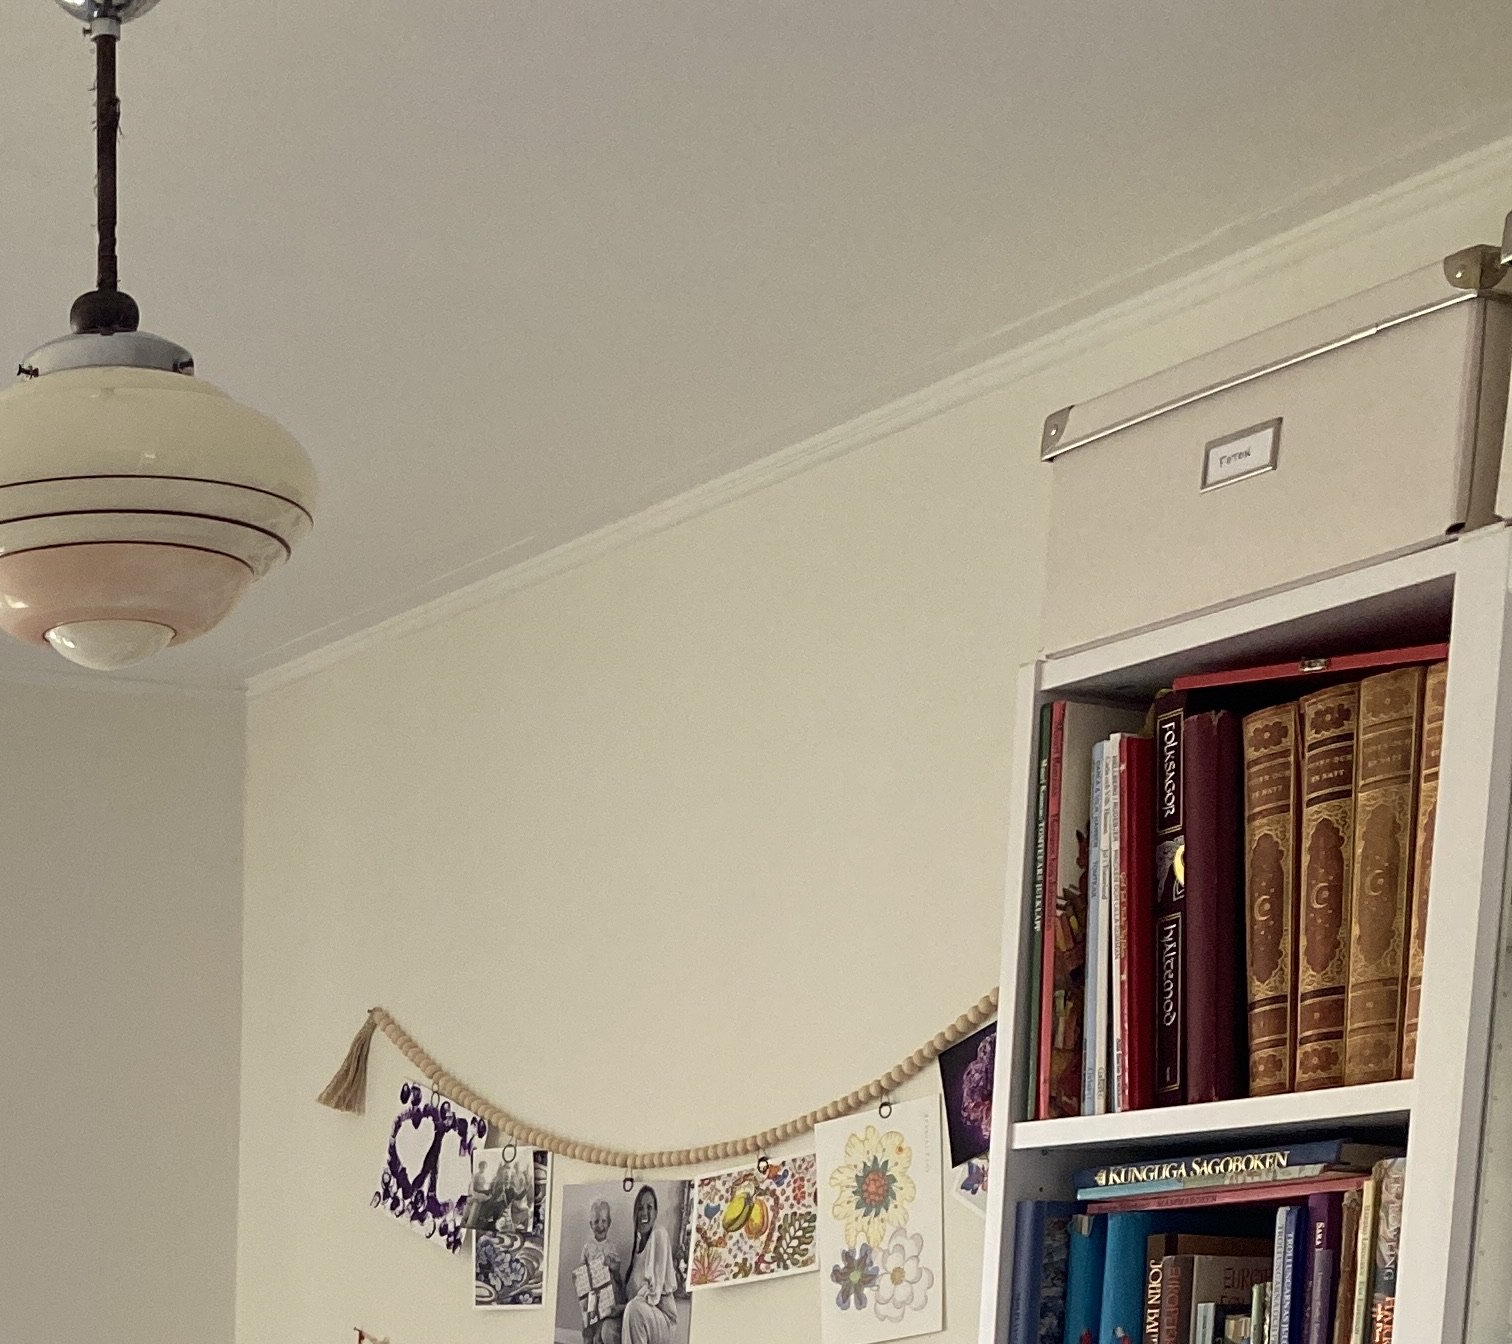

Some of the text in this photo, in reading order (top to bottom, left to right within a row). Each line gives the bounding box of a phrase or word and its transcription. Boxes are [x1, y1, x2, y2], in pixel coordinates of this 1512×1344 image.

[1161, 722, 1178, 818] FOLKSAGOR
[1107, 1149, 1291, 1185] KUNGLIGA SAGOBOKEN
[1313, 1221, 1325, 1246] SARA
[1146, 1259, 1164, 1304] JOHN
